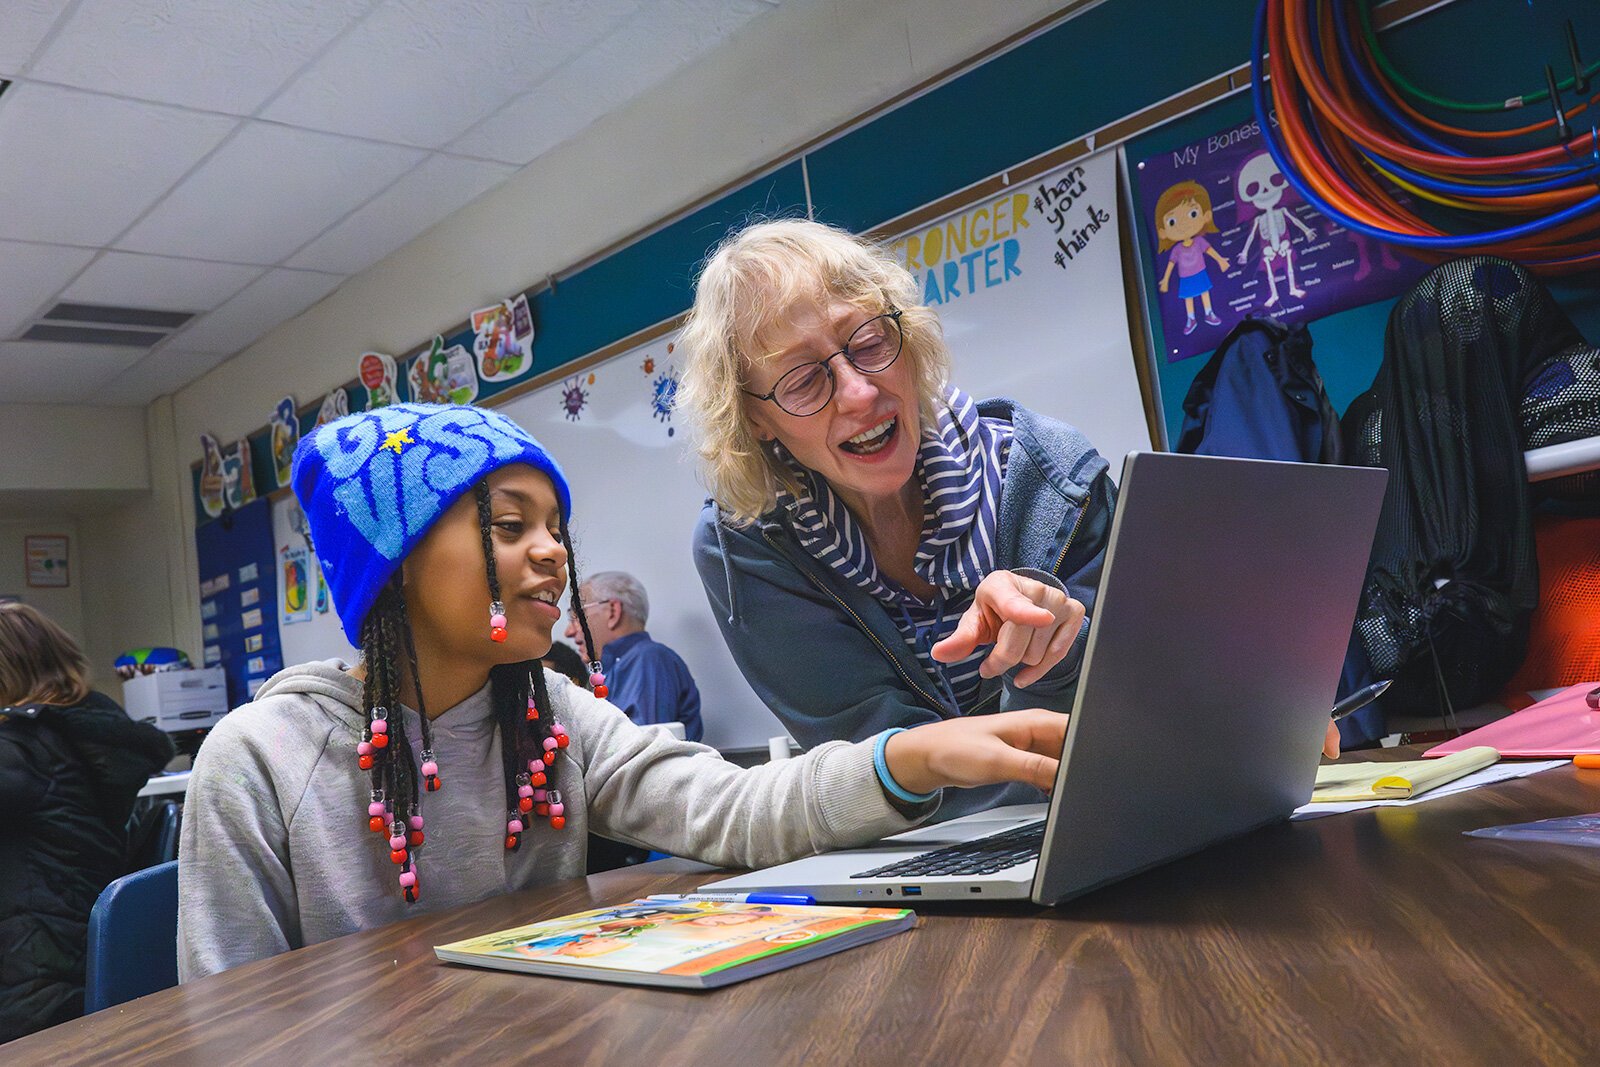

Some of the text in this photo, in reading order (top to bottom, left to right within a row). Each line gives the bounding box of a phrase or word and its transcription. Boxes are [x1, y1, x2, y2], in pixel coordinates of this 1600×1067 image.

[1173, 145, 1200, 169] My
[1207, 120, 1261, 154] Bones
[891, 193, 1030, 270] RONGER
[1046, 180, 1088, 234] you
[913, 239, 1022, 306] ARTER
